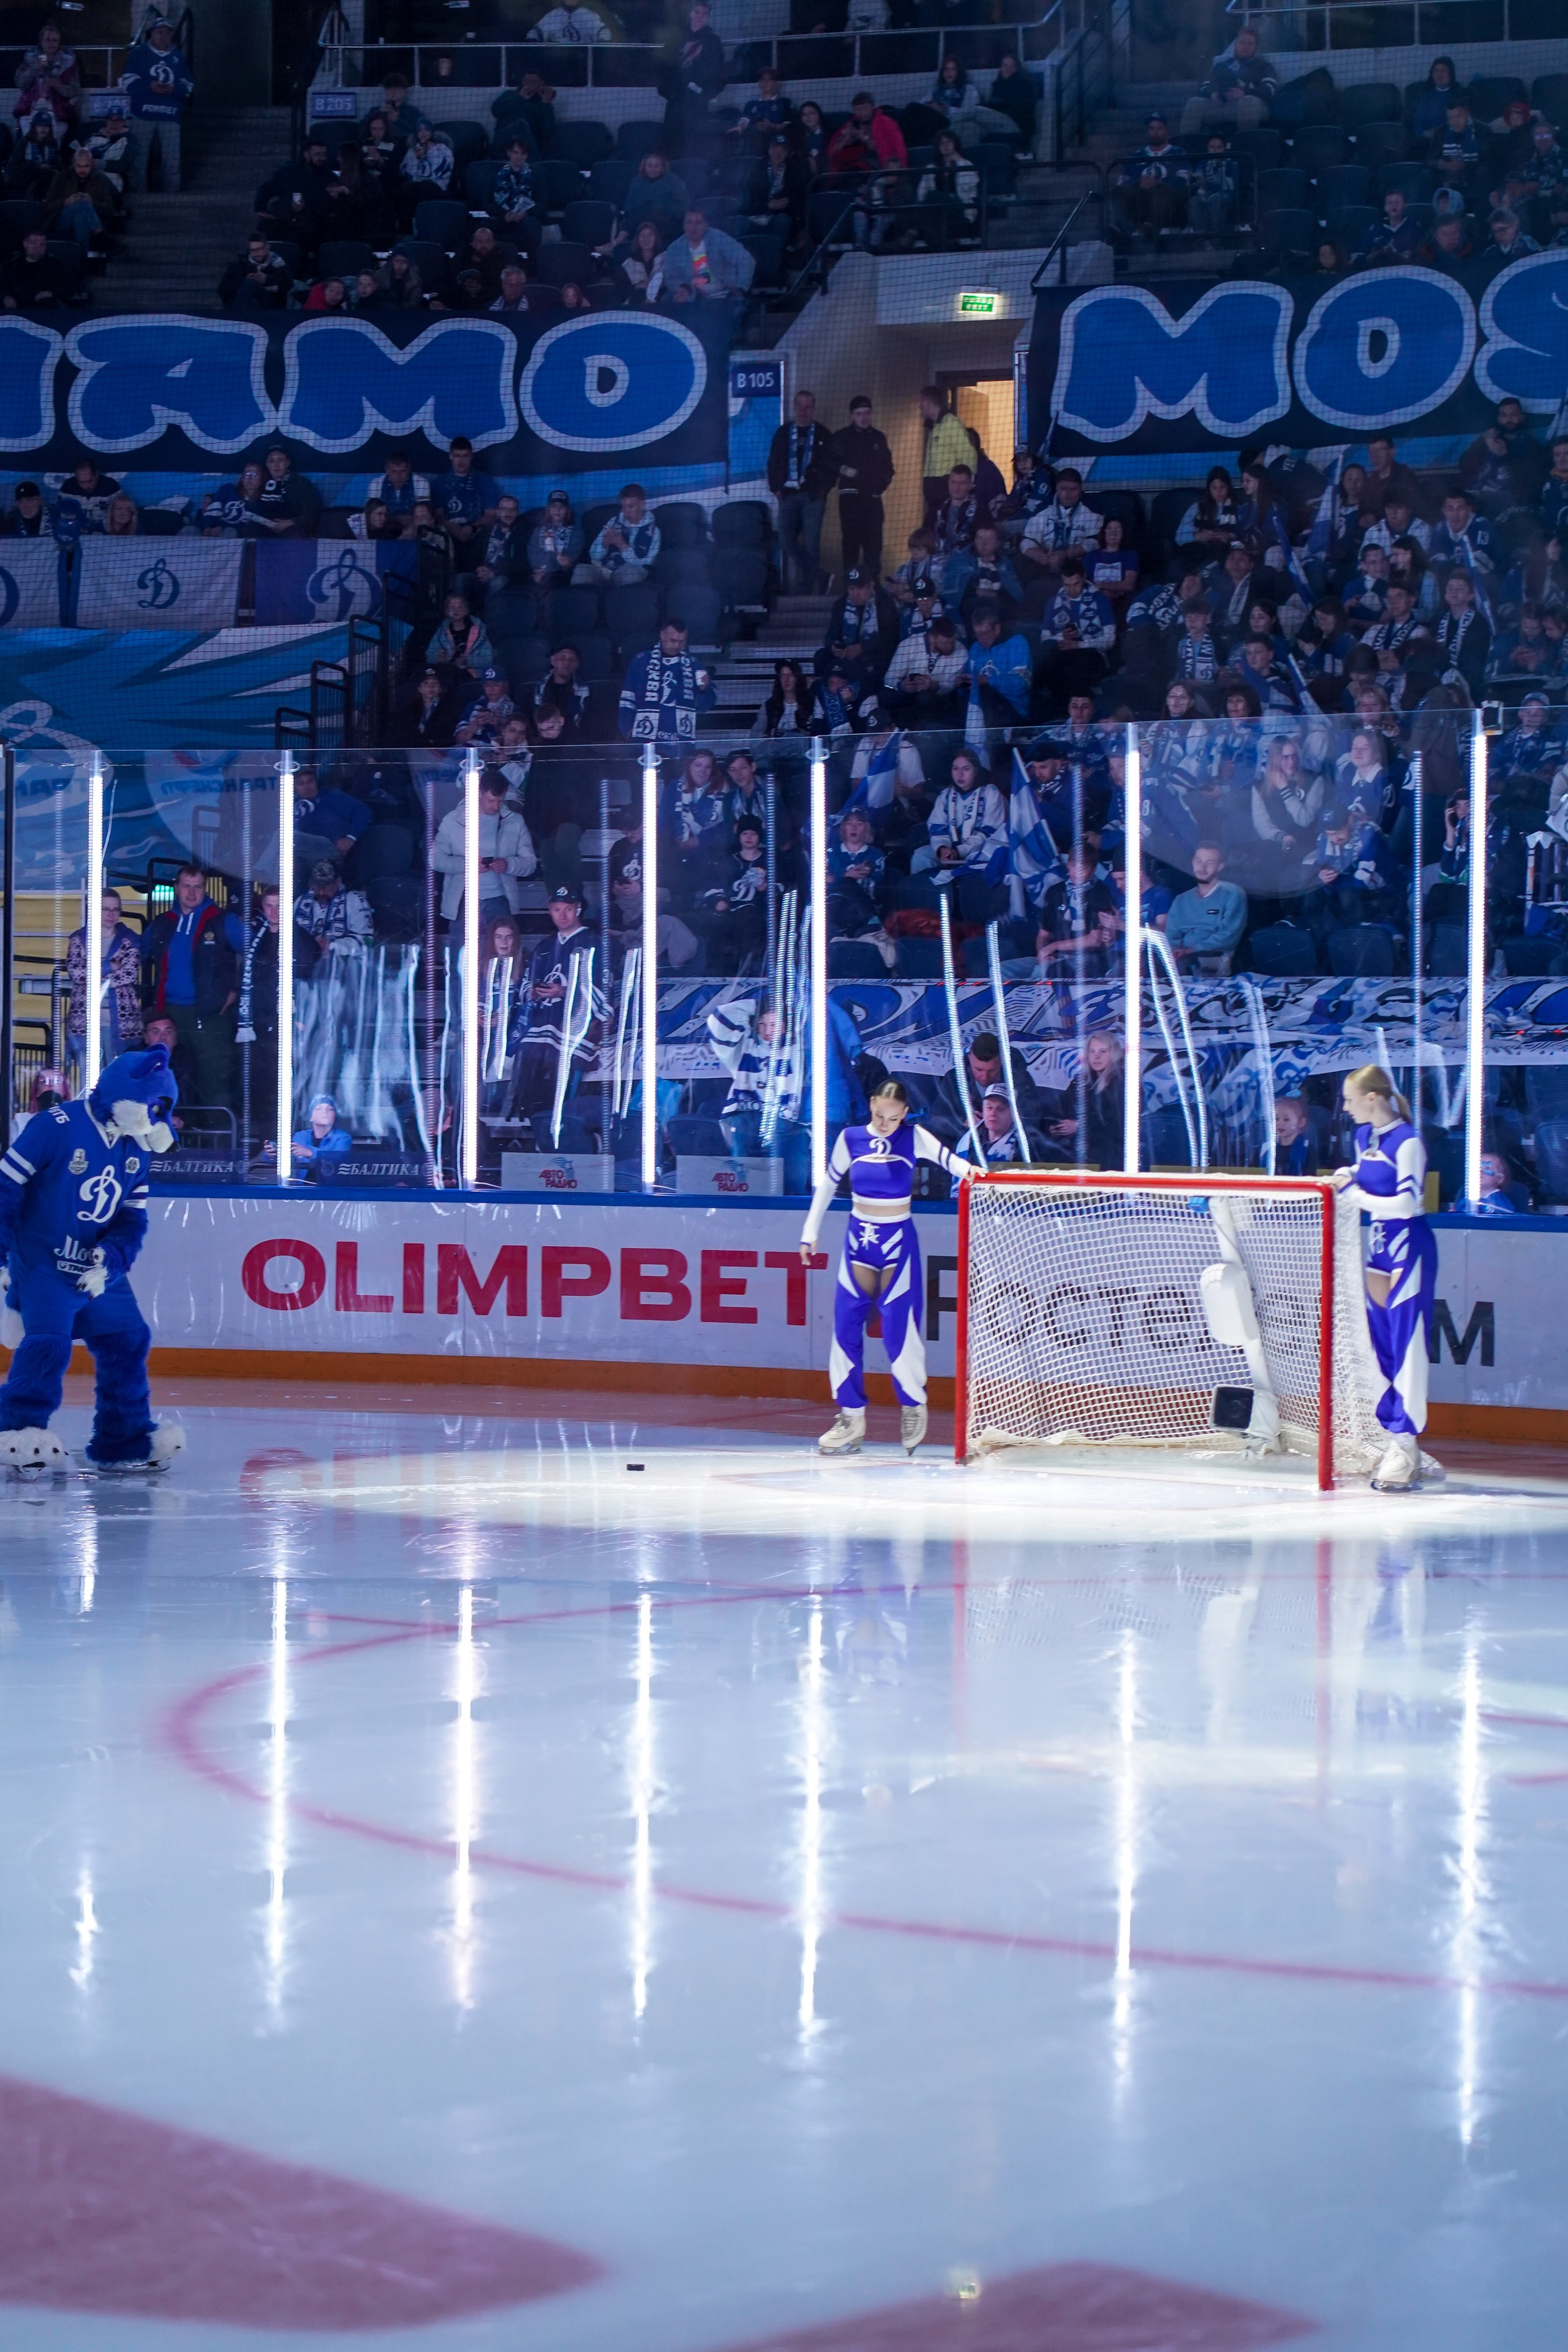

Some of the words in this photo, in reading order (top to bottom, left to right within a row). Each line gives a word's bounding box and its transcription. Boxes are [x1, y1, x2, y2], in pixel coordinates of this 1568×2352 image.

[326, 98, 352, 111] 205
[748, 372, 774, 387] 105
[162, 1161, 234, 1173] БАЛТИКА
[350, 1163, 420, 1175] БАЛТИКА
[538, 1169, 565, 1179] АВТО
[711, 1172, 736, 1182] АВТО
[545, 1179, 578, 1189] РАДИО
[718, 1182, 749, 1192] РАДИО
[241, 1238, 829, 1326] OLIMPBET
